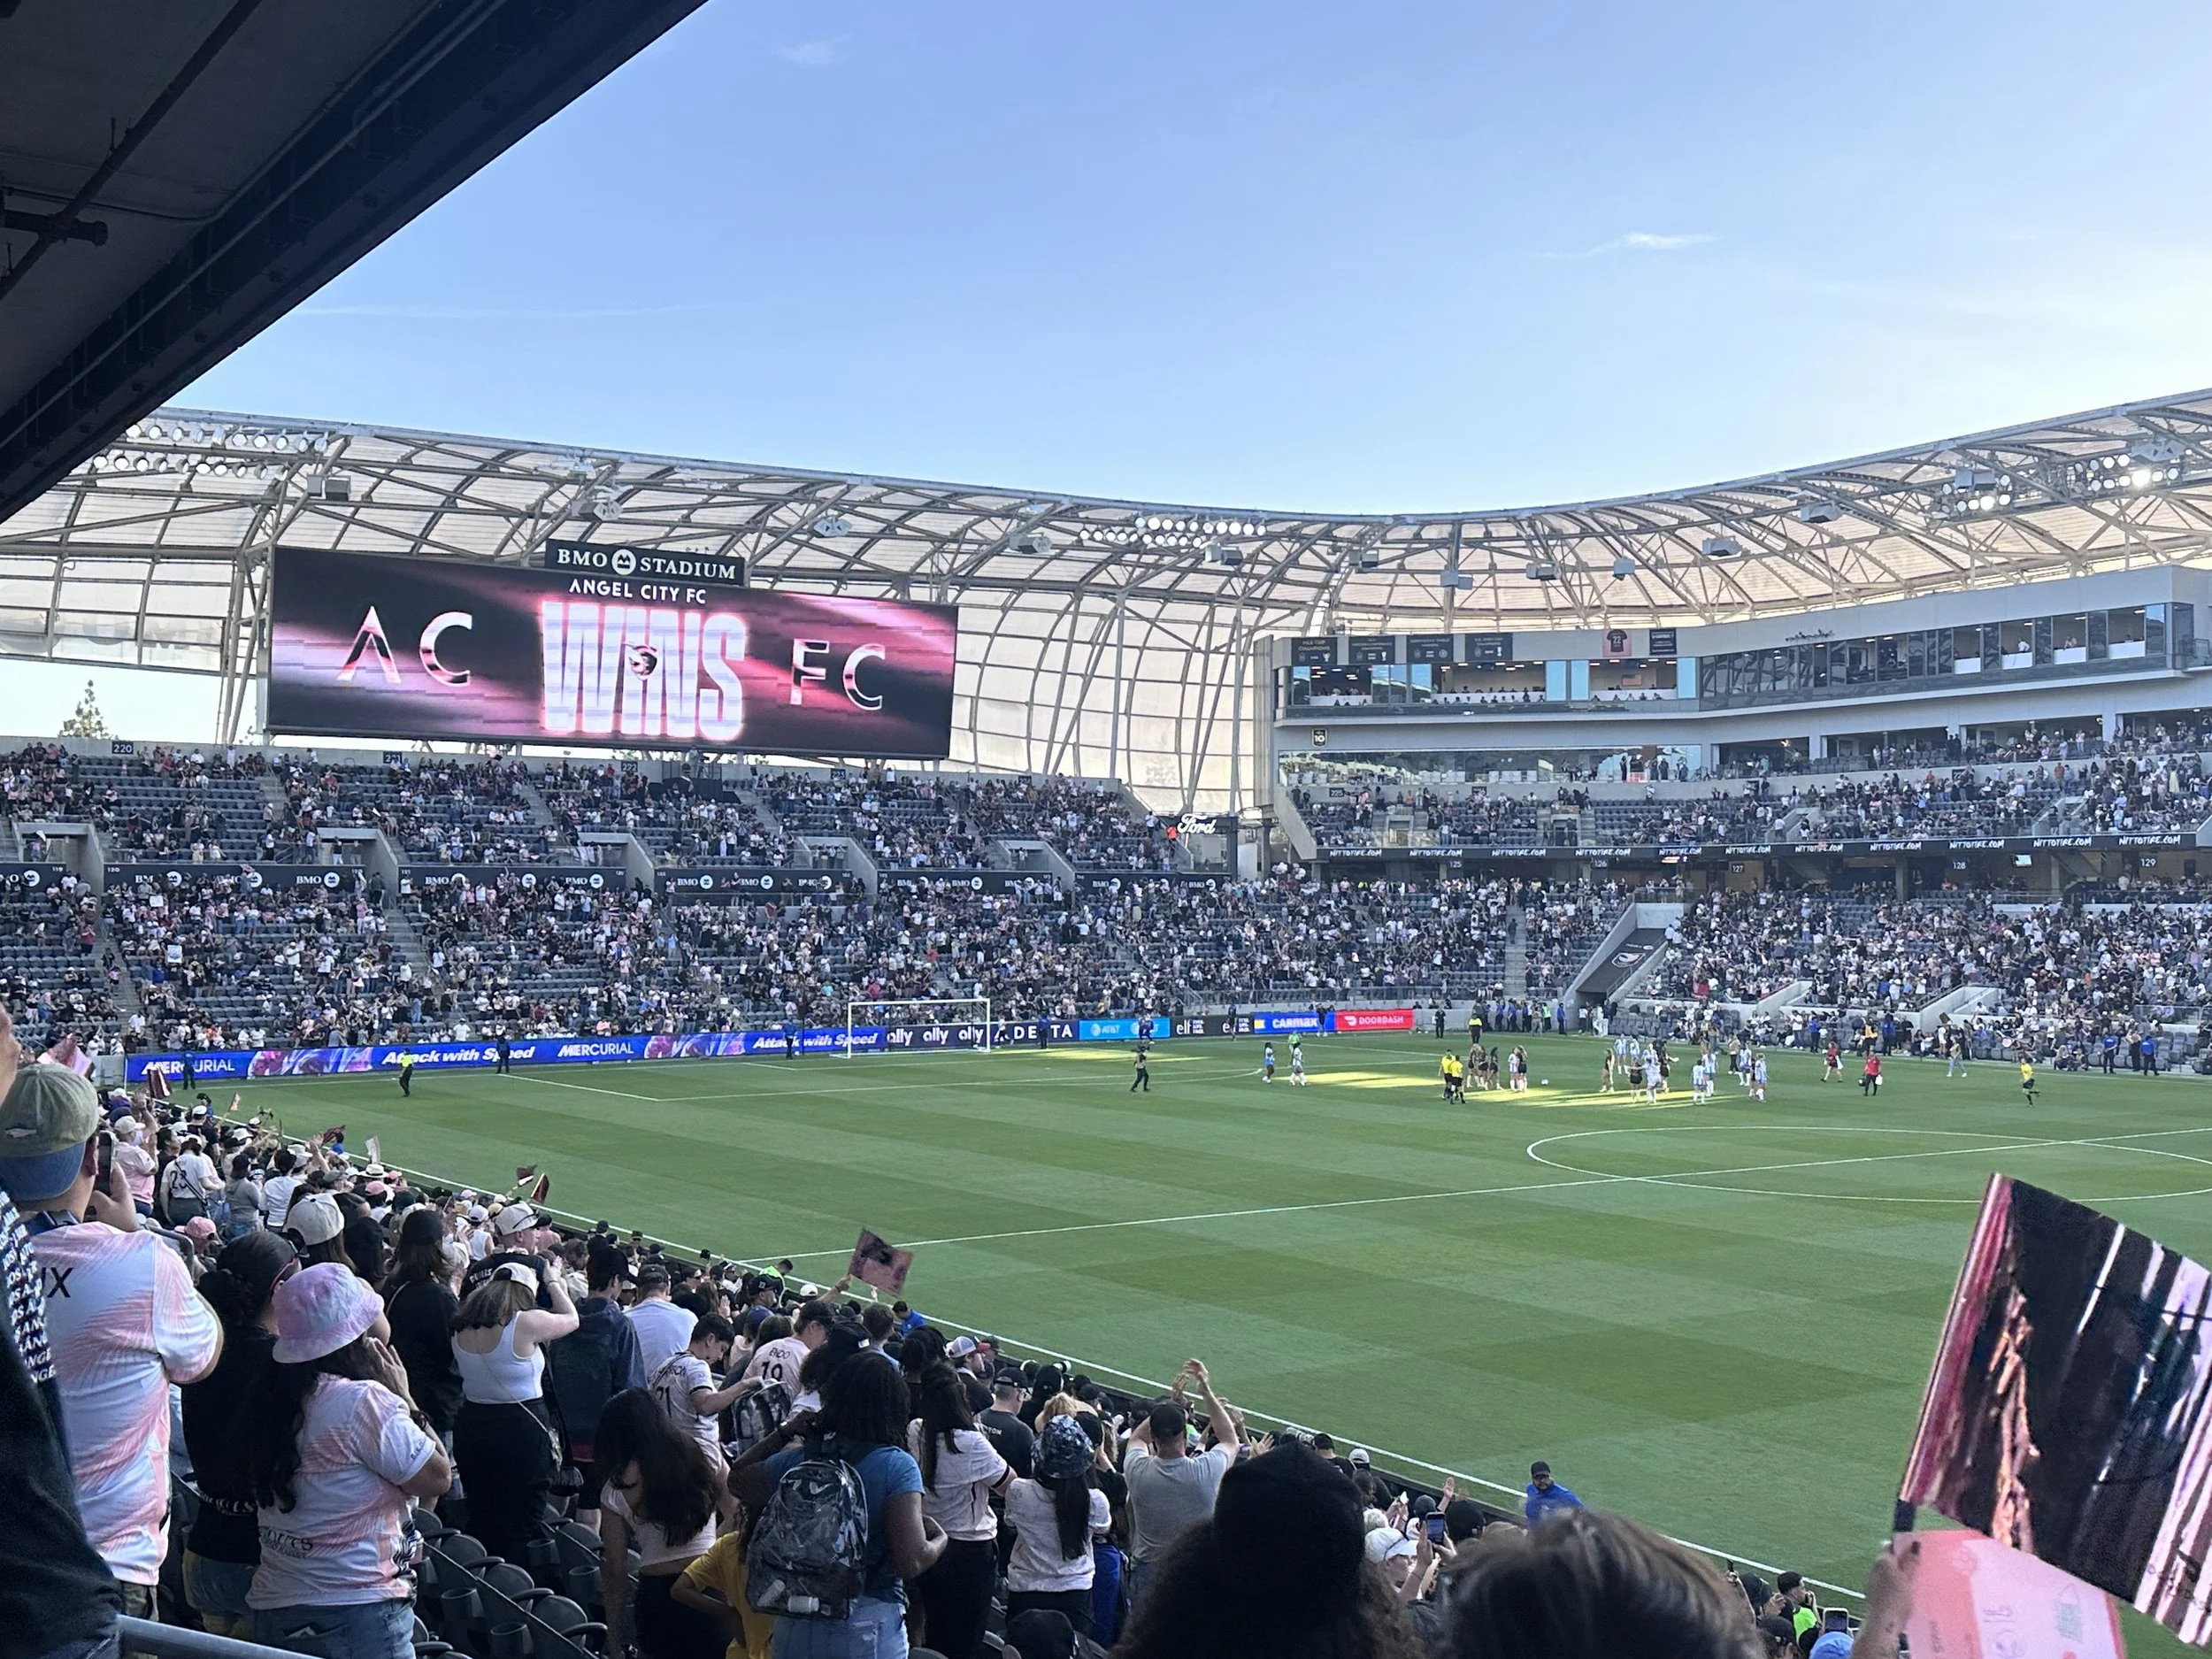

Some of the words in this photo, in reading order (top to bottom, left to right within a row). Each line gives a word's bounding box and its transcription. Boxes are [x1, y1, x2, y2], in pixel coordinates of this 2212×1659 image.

[557, 549, 608, 568] BMO
[640, 557, 736, 580] STADIUM
[569, 578, 634, 599] ANGEL
[640, 585, 680, 602] CITY
[686, 588, 706, 604] FC
[541, 601, 747, 742] WINS
[113, 744, 133, 753] 220
[1177, 813, 1217, 834] Ford
[2032, 836, 2092, 848] NITTOTIRE.COM
[2118, 834, 2181, 846] NITTOTIRE.COM
[1732, 864, 1744, 873] 127
[1952, 861, 1967, 870] 128
[2140, 857, 2156, 867] 129
[296, 875, 322, 885] BMO
[425, 876, 449, 885] BMO
[677, 878, 699, 887] BMO
[1358, 1015, 1404, 1025] DOORDASH
[887, 1028, 913, 1046] ally
[923, 1026, 949, 1045] ally
[958, 1025, 984, 1044] ally
[1013, 1024, 1073, 1040] DETA
[803, 1034, 833, 1046] with
[834, 1033, 879, 1047] Speed
[442, 1048, 480, 1062] with
[557, 1041, 634, 1057] MERCURIAL
[142, 1059, 235, 1075] MERURIAL
[769, 1347, 791, 1360] ENDO
